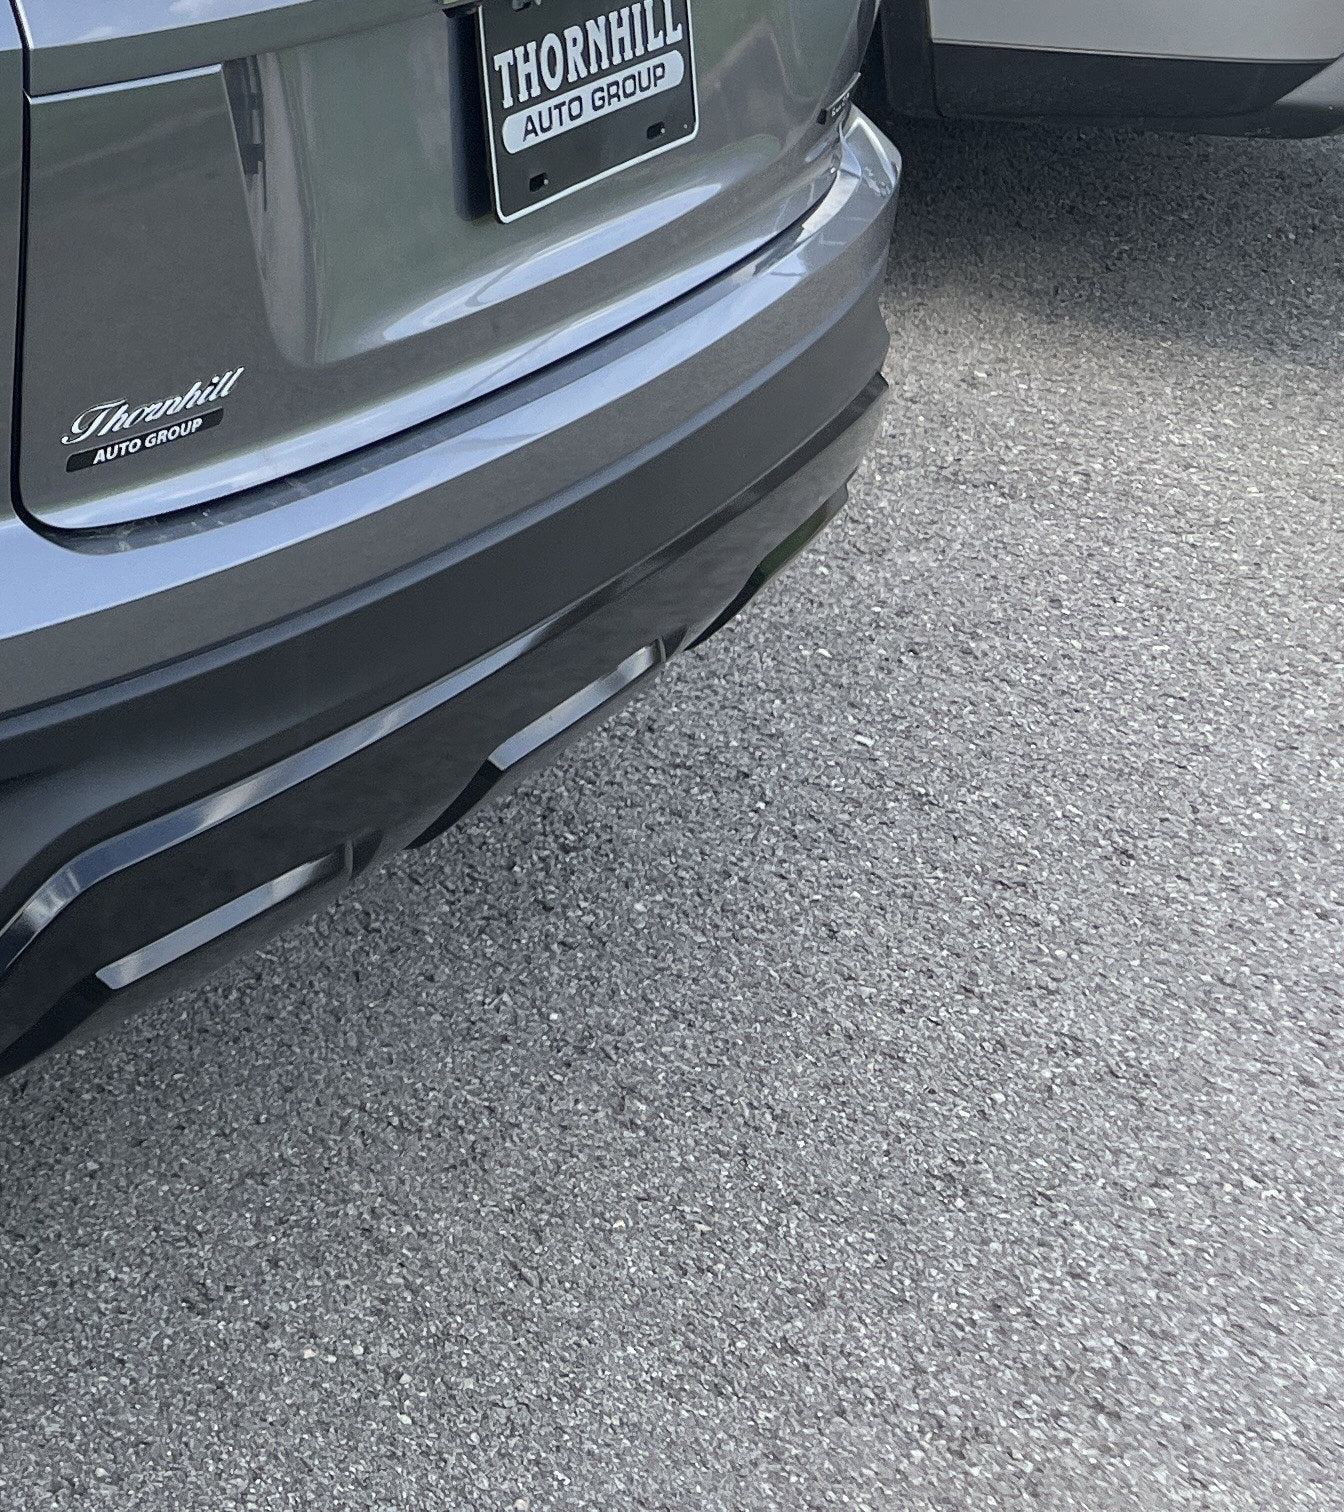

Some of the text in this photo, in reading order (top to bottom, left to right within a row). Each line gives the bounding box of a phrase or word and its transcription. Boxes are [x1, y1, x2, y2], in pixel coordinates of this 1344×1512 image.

[523, 61, 666, 142] AUTO GROUP
[60, 365, 245, 445] Thornhill
[92, 417, 204, 465] AUTO GROUP
